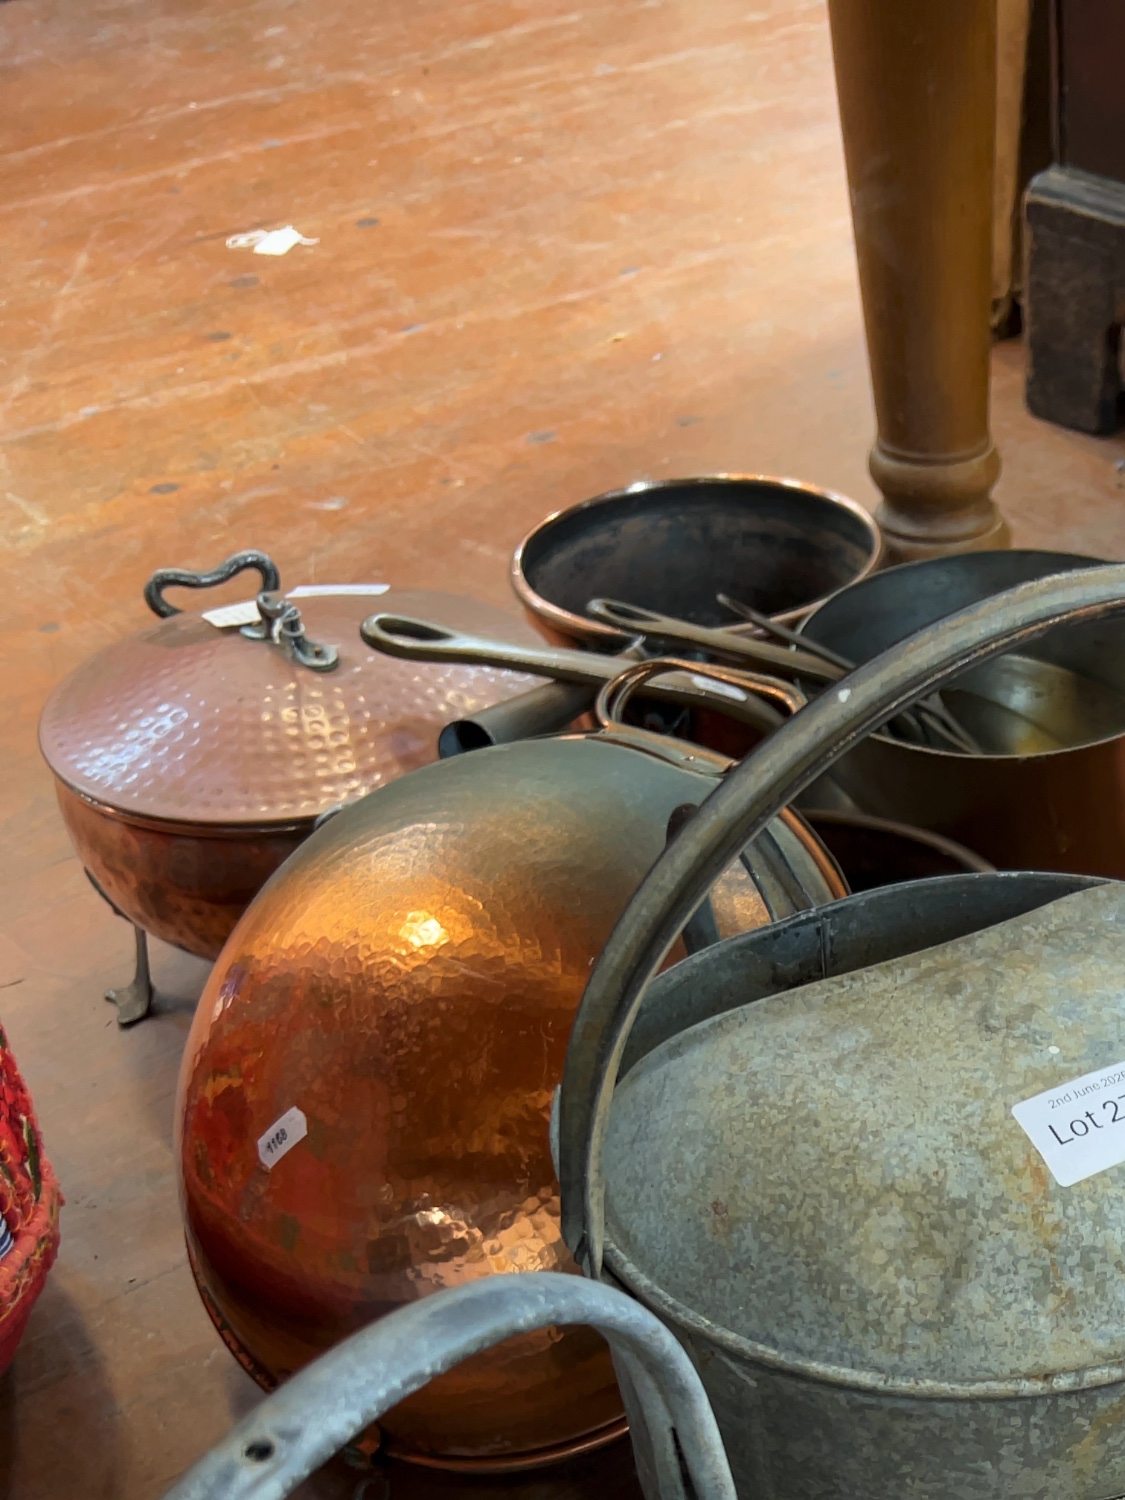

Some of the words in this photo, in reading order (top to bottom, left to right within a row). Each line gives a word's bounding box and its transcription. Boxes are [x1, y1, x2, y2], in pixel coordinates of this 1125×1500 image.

[1047, 1092, 1072, 1110] 2nd
[1073, 1081, 1101, 1100] June
[1048, 1110, 1104, 1145] Lot
